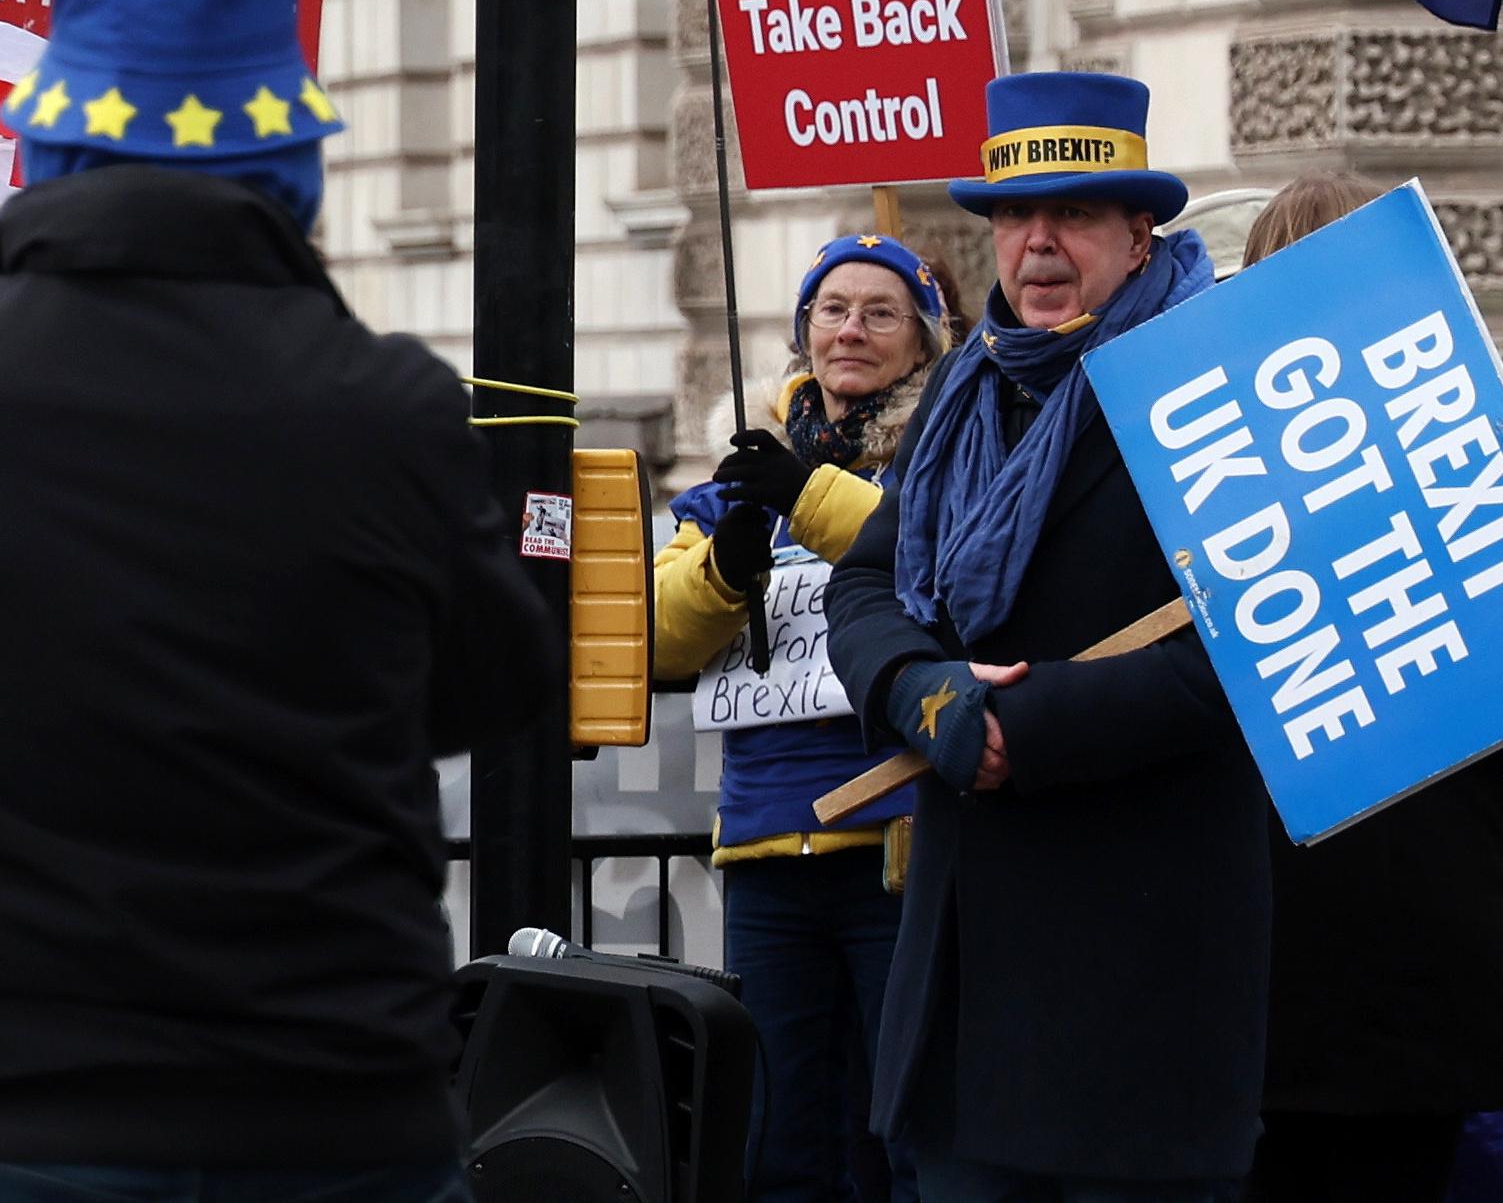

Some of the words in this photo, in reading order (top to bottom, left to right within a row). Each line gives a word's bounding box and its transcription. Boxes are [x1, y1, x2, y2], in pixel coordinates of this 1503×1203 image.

[784, 77, 944, 147] Control
[989, 141, 1022, 173] WHY
[1027, 137, 1116, 165] BREXIT?
[1149, 365, 1269, 515] UK
[1254, 336, 1395, 515] GOT
[1331, 510, 1470, 695] THE
[1202, 501, 1376, 761] DONE
[710, 665, 834, 724] Brexit
